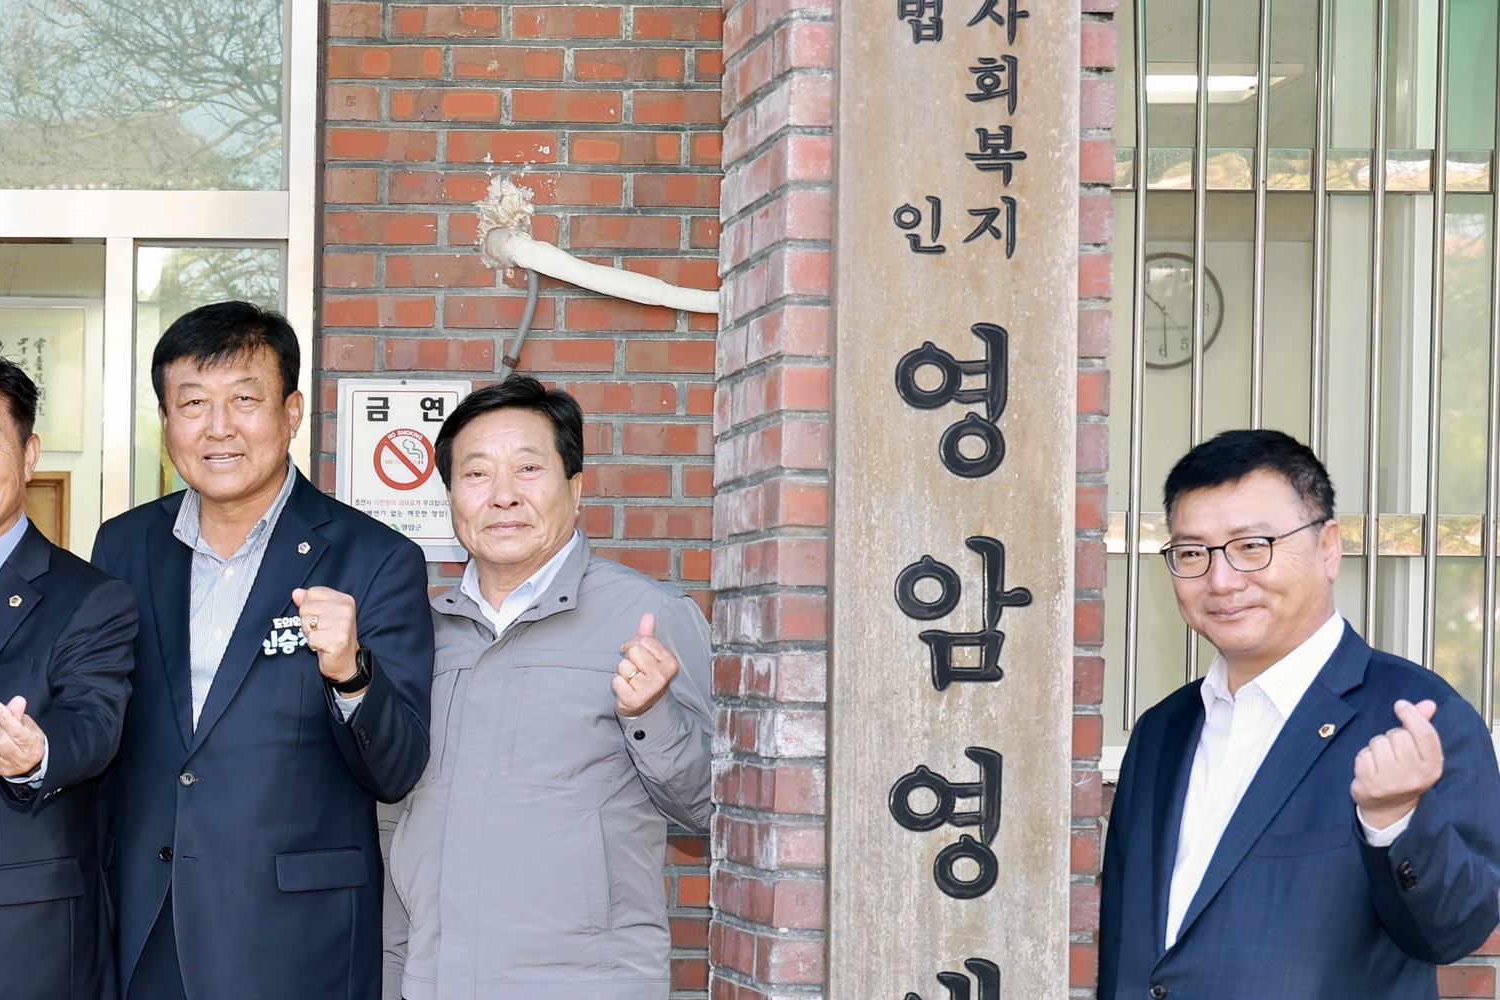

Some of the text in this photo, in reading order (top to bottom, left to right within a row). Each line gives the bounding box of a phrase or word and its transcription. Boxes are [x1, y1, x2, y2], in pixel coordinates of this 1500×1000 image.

[963, 0, 1029, 259] 사회복지
[387, 429, 423, 441] NO SMOKING
[400, 523, 421, 531] 영암군
